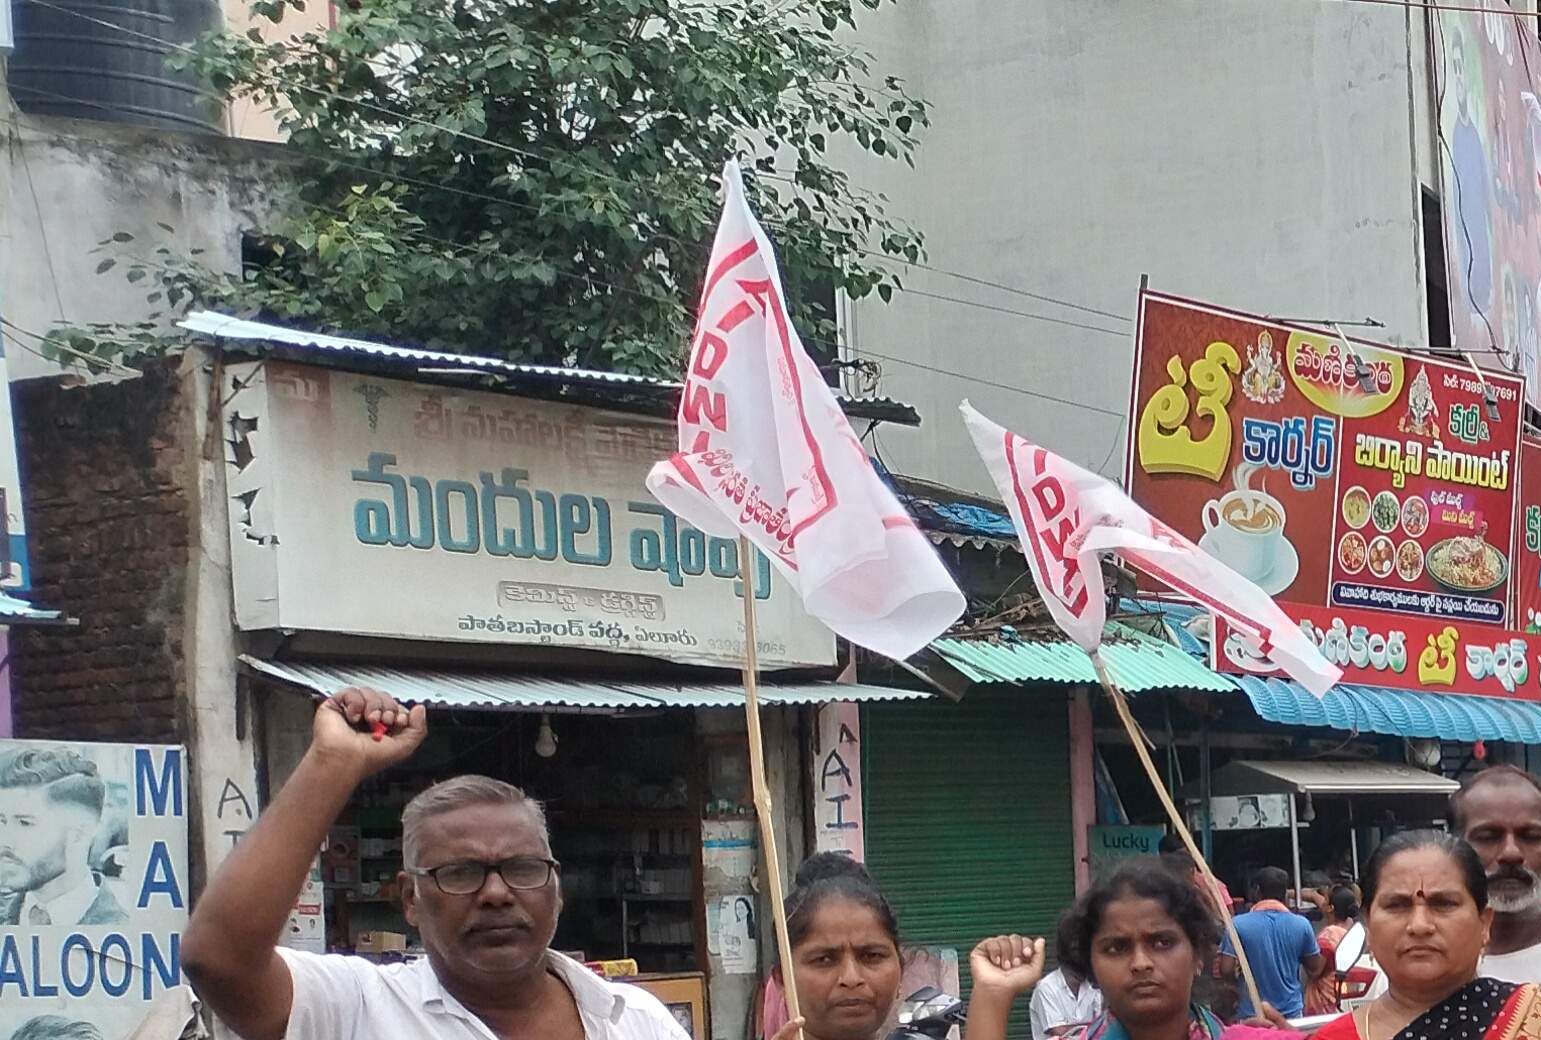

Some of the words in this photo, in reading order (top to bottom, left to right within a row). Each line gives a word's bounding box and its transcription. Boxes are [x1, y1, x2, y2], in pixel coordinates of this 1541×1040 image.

[1138, 341, 1242, 486] టీ
[1242, 416, 1336, 491] కార్నర్
[1424, 438, 1511, 491] పాయింట్
[351, 450, 612, 568] మందుల
[1417, 626, 1459, 687] టీ
[1101, 831, 1150, 851] Lucky
